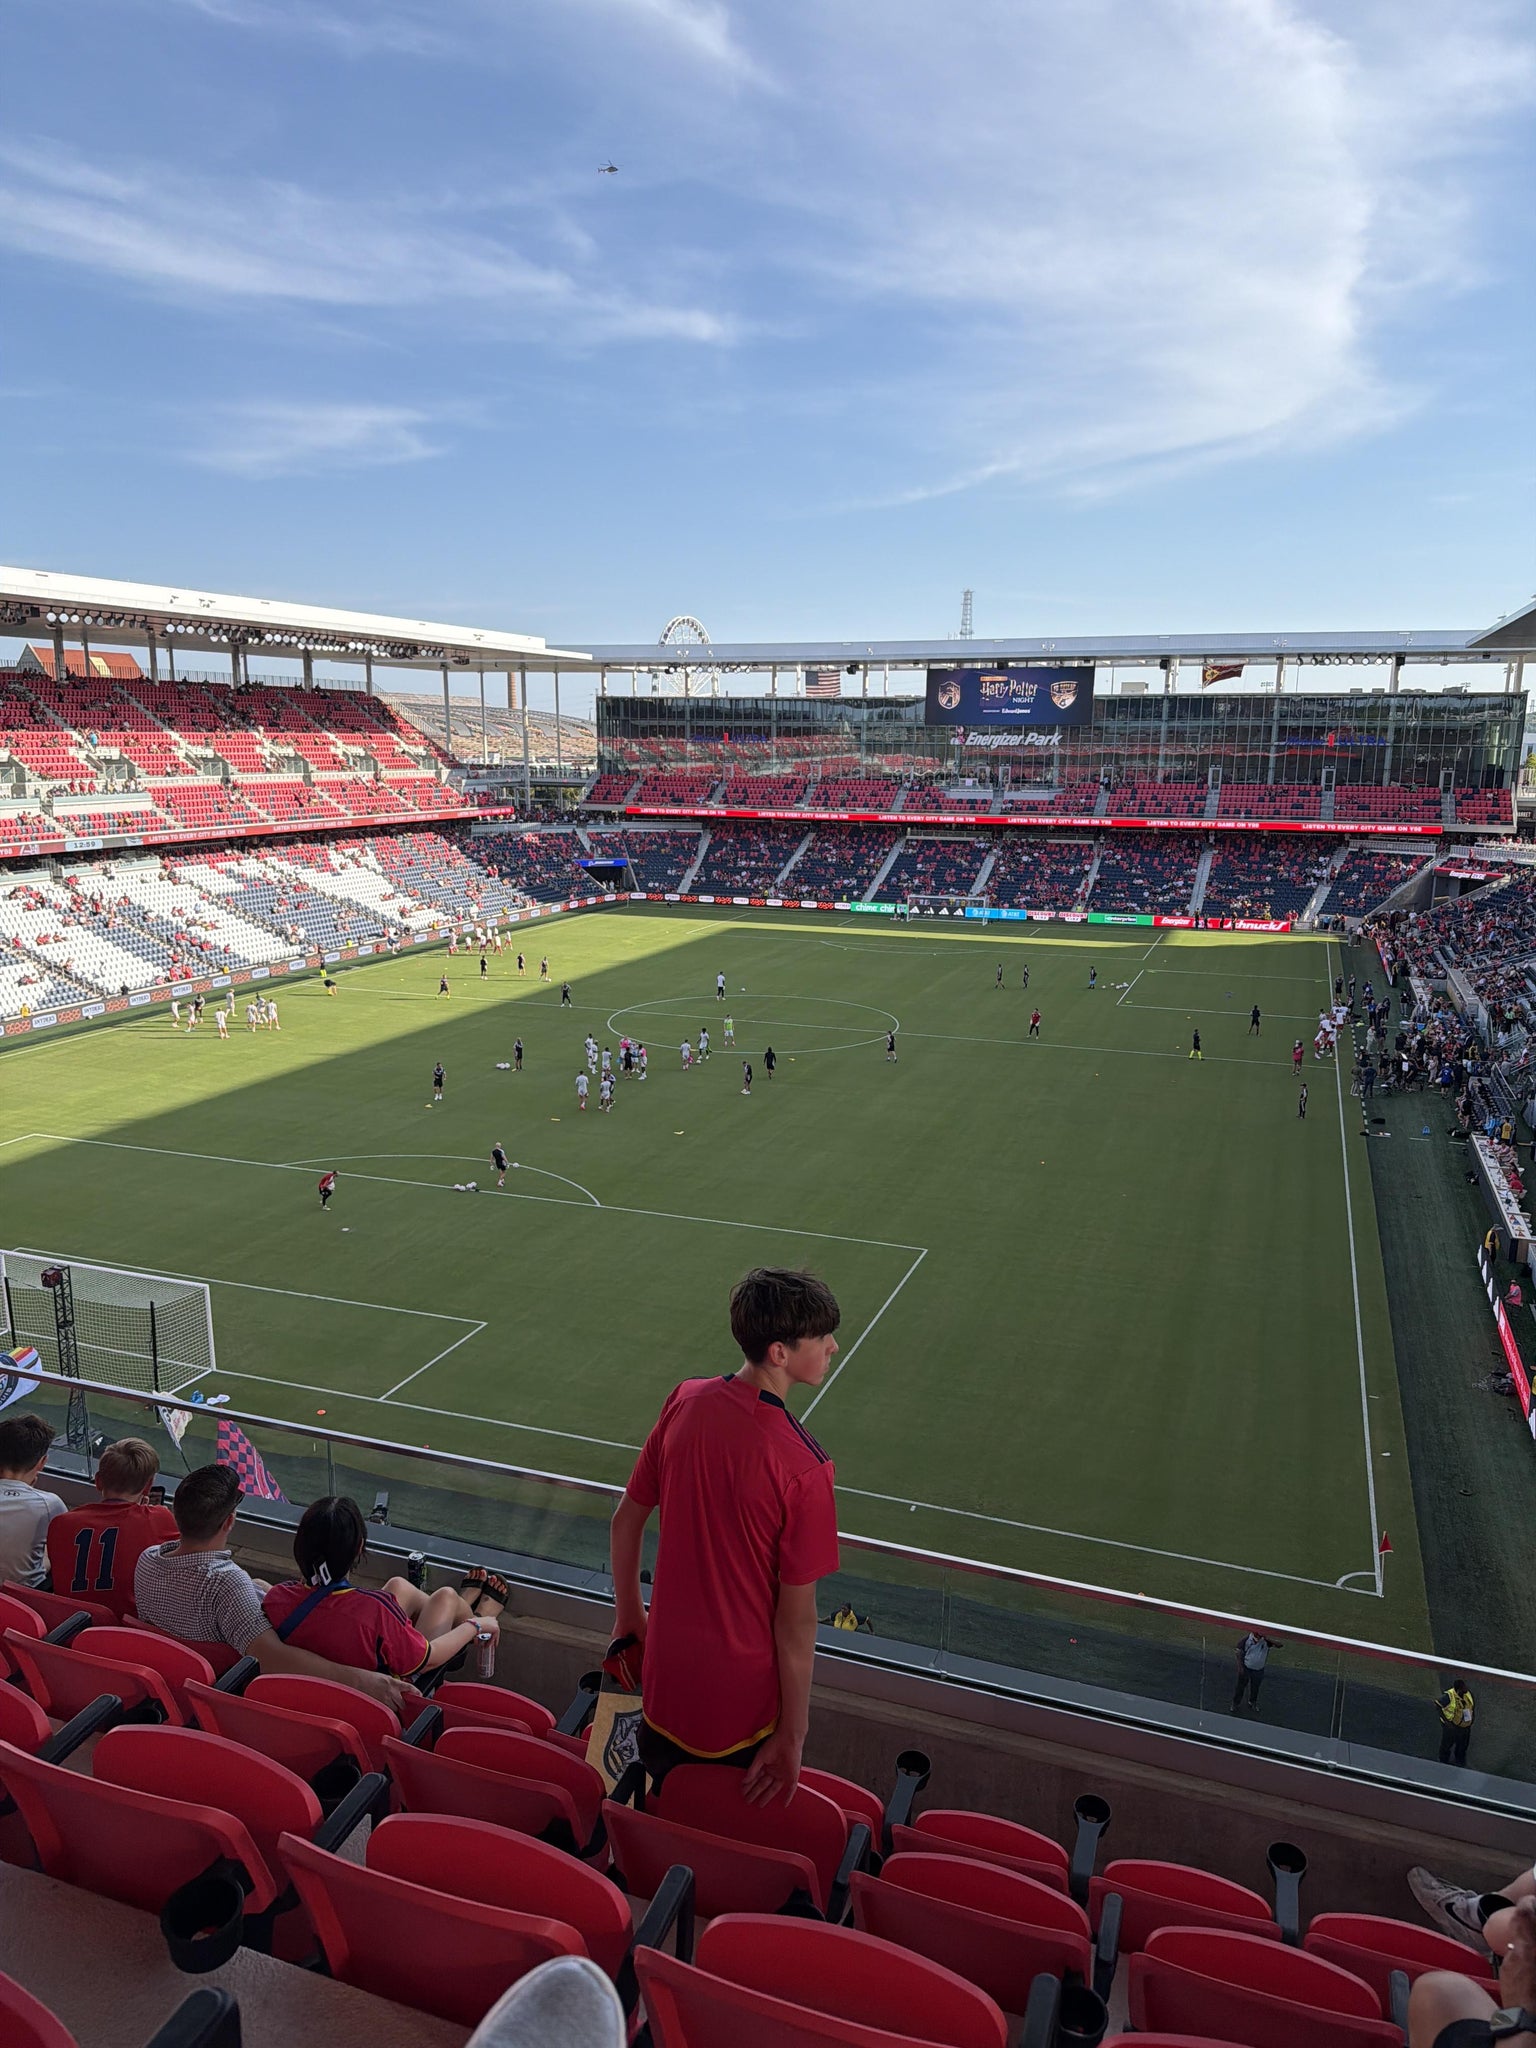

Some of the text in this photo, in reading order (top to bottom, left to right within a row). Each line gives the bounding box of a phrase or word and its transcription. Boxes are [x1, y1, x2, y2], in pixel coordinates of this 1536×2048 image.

[980, 682, 1009, 698] Harry
[1009, 679, 1038, 696] Potter
[965, 732, 1063, 749] Energizer Park
[1339, 735, 1386, 745] ULTRA
[73, 841, 96, 849] 12:59
[856, 904, 877, 912] chime
[1161, 917, 1191, 925] Energizer
[71, 1527, 119, 1593] 11
